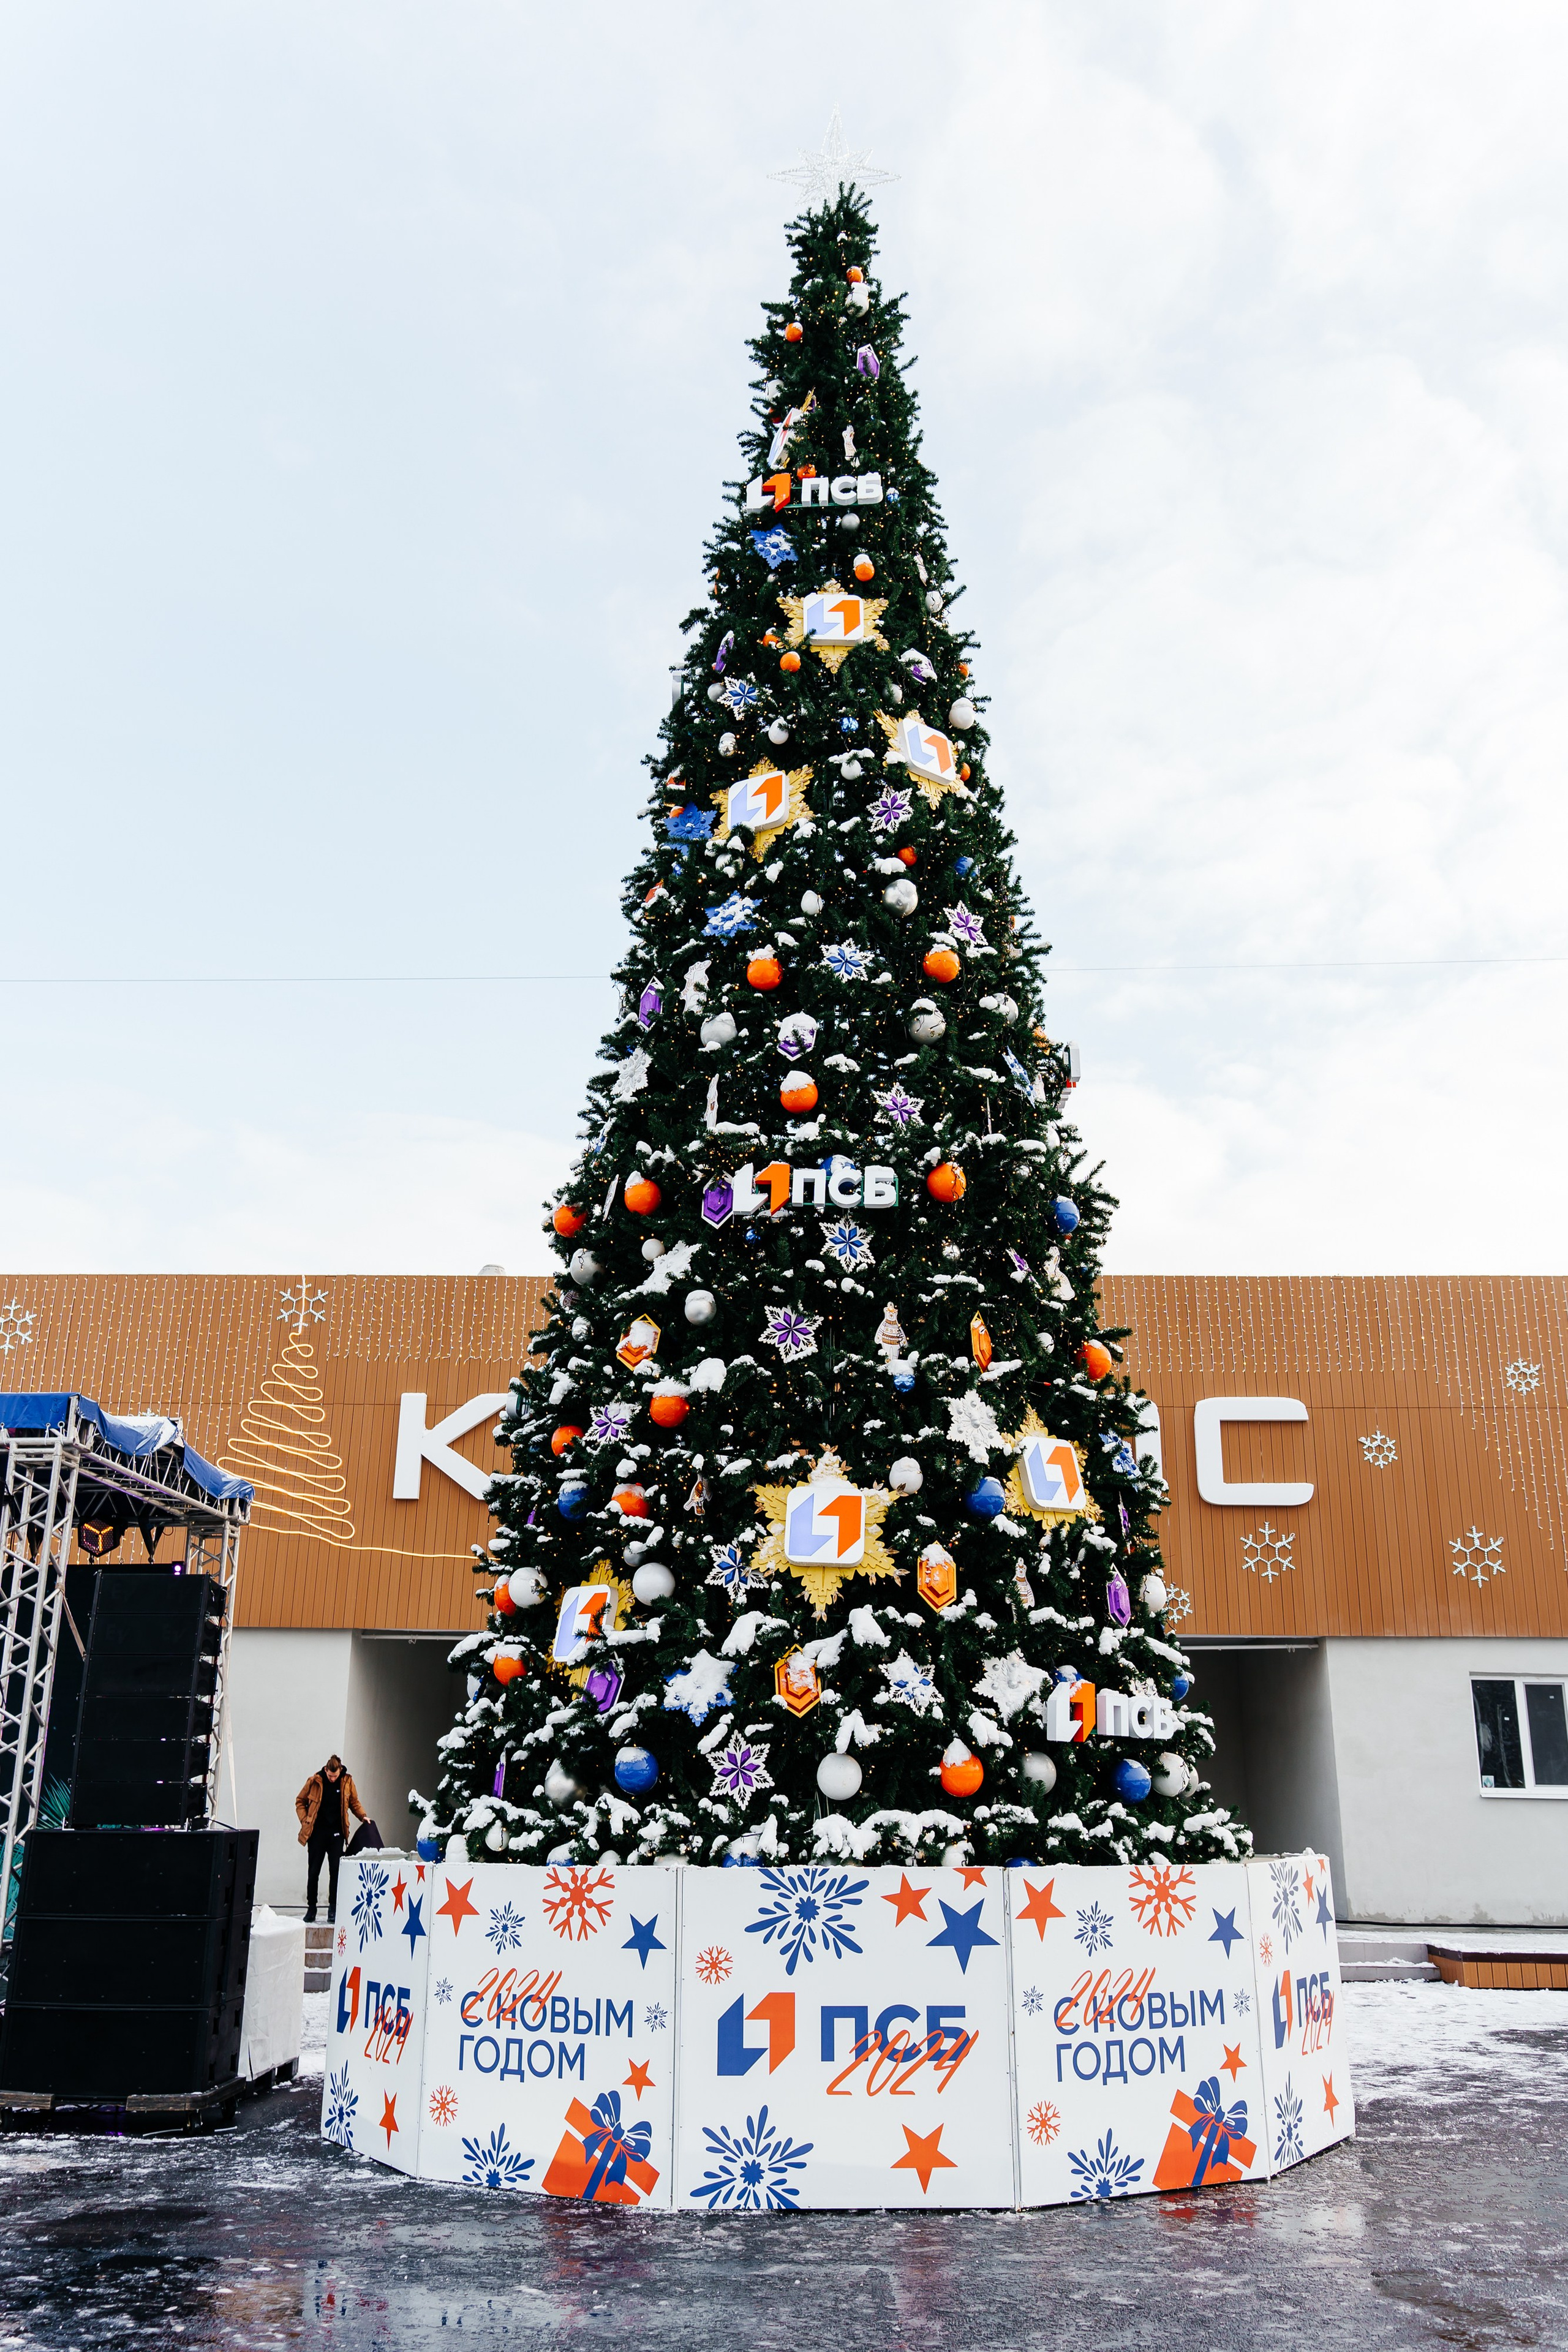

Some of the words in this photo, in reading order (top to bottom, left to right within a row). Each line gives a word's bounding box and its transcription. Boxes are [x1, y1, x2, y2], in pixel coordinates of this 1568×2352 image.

[801, 473, 883, 507] ПСБ
[792, 1166, 897, 1208] ПСБ
[1097, 1692, 1174, 1740] ПСБ
[364, 1980, 410, 2038] ПСБ
[461, 1991, 484, 2027] С
[496, 1993, 633, 2038] НОВЫМ
[462, 1967, 562, 2022] 2024
[1054, 1997, 1080, 2035] С
[1092, 1989, 1225, 2033] НОВЫМ
[1056, 1967, 1156, 2026] 2024
[1297, 1972, 1332, 2028] ПСБ
[364, 2005, 414, 2065] 2024
[821, 2004, 971, 2062] ПСБ
[1302, 1991, 1335, 2056] 2024
[459, 2034, 585, 2082] ГОДОМ
[826, 2030, 979, 2097] 2024
[1056, 2035, 1186, 2086] ГОДОМ
